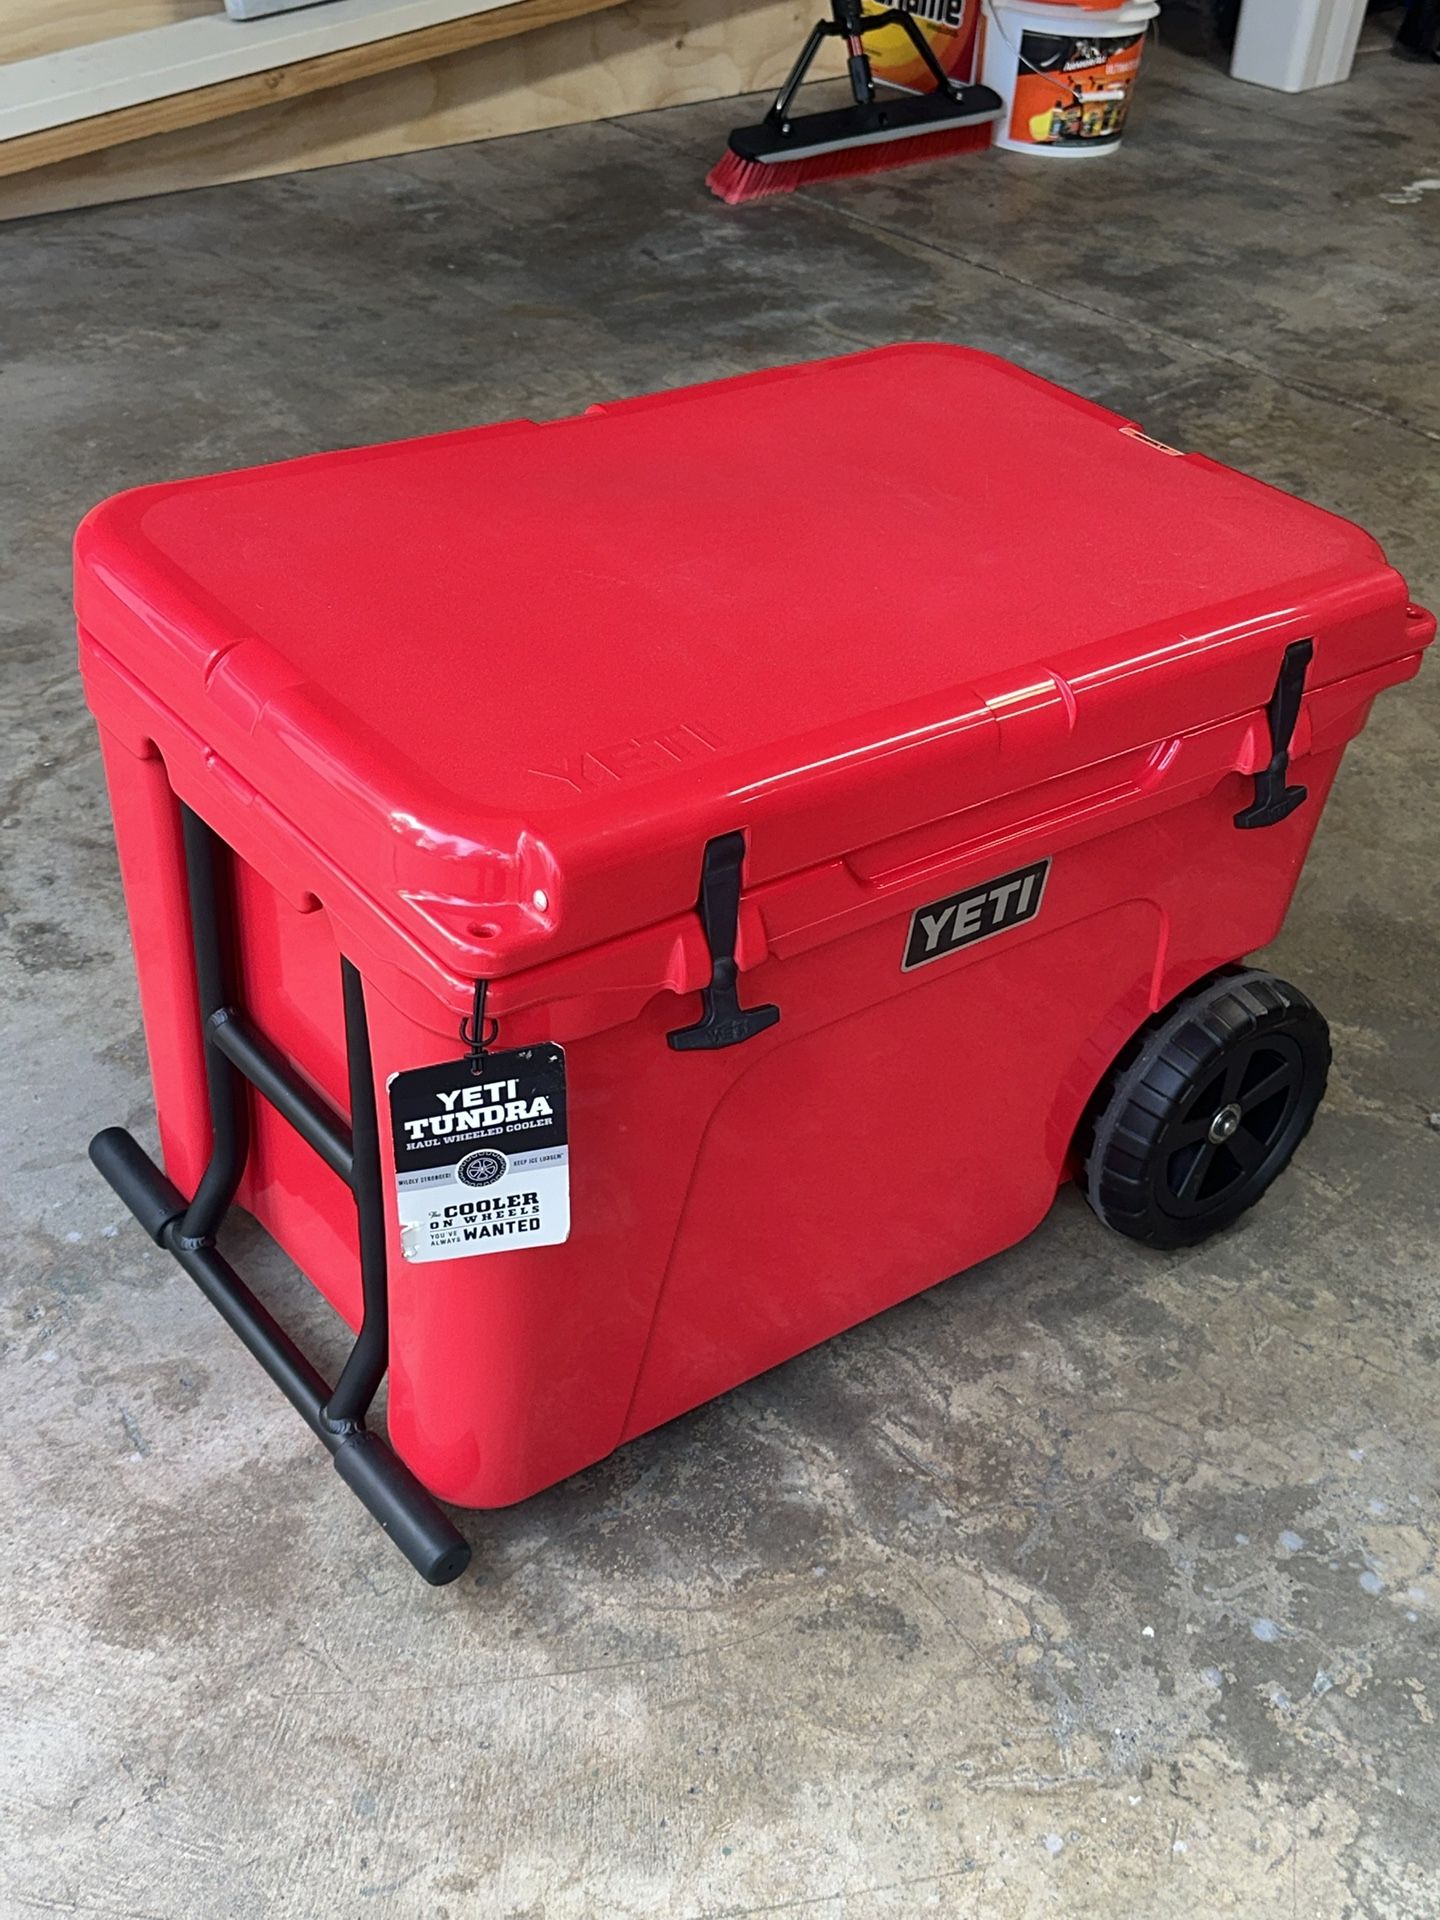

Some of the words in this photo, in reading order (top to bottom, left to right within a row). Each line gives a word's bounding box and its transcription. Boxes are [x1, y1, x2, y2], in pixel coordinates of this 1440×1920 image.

[528, 724, 724, 792] YETI
[920, 873, 1036, 952] YETI
[436, 1079, 517, 1112] YETI
[404, 1096, 553, 1140] TUNDRA
[406, 1139, 441, 1151] HAUL
[443, 1127, 504, 1144] WHEELED
[506, 1117, 553, 1133] COOLER
[398, 1178, 419, 1186] WILDLY
[430, 1219, 453, 1230] ON
[463, 1205, 540, 1224] WHEELS
[444, 1192, 539, 1218] COOLER
[430, 1230, 457, 1240] YOU'VE
[431, 1237, 461, 1247] ALWAYS
[463, 1217, 540, 1241] WANTED
